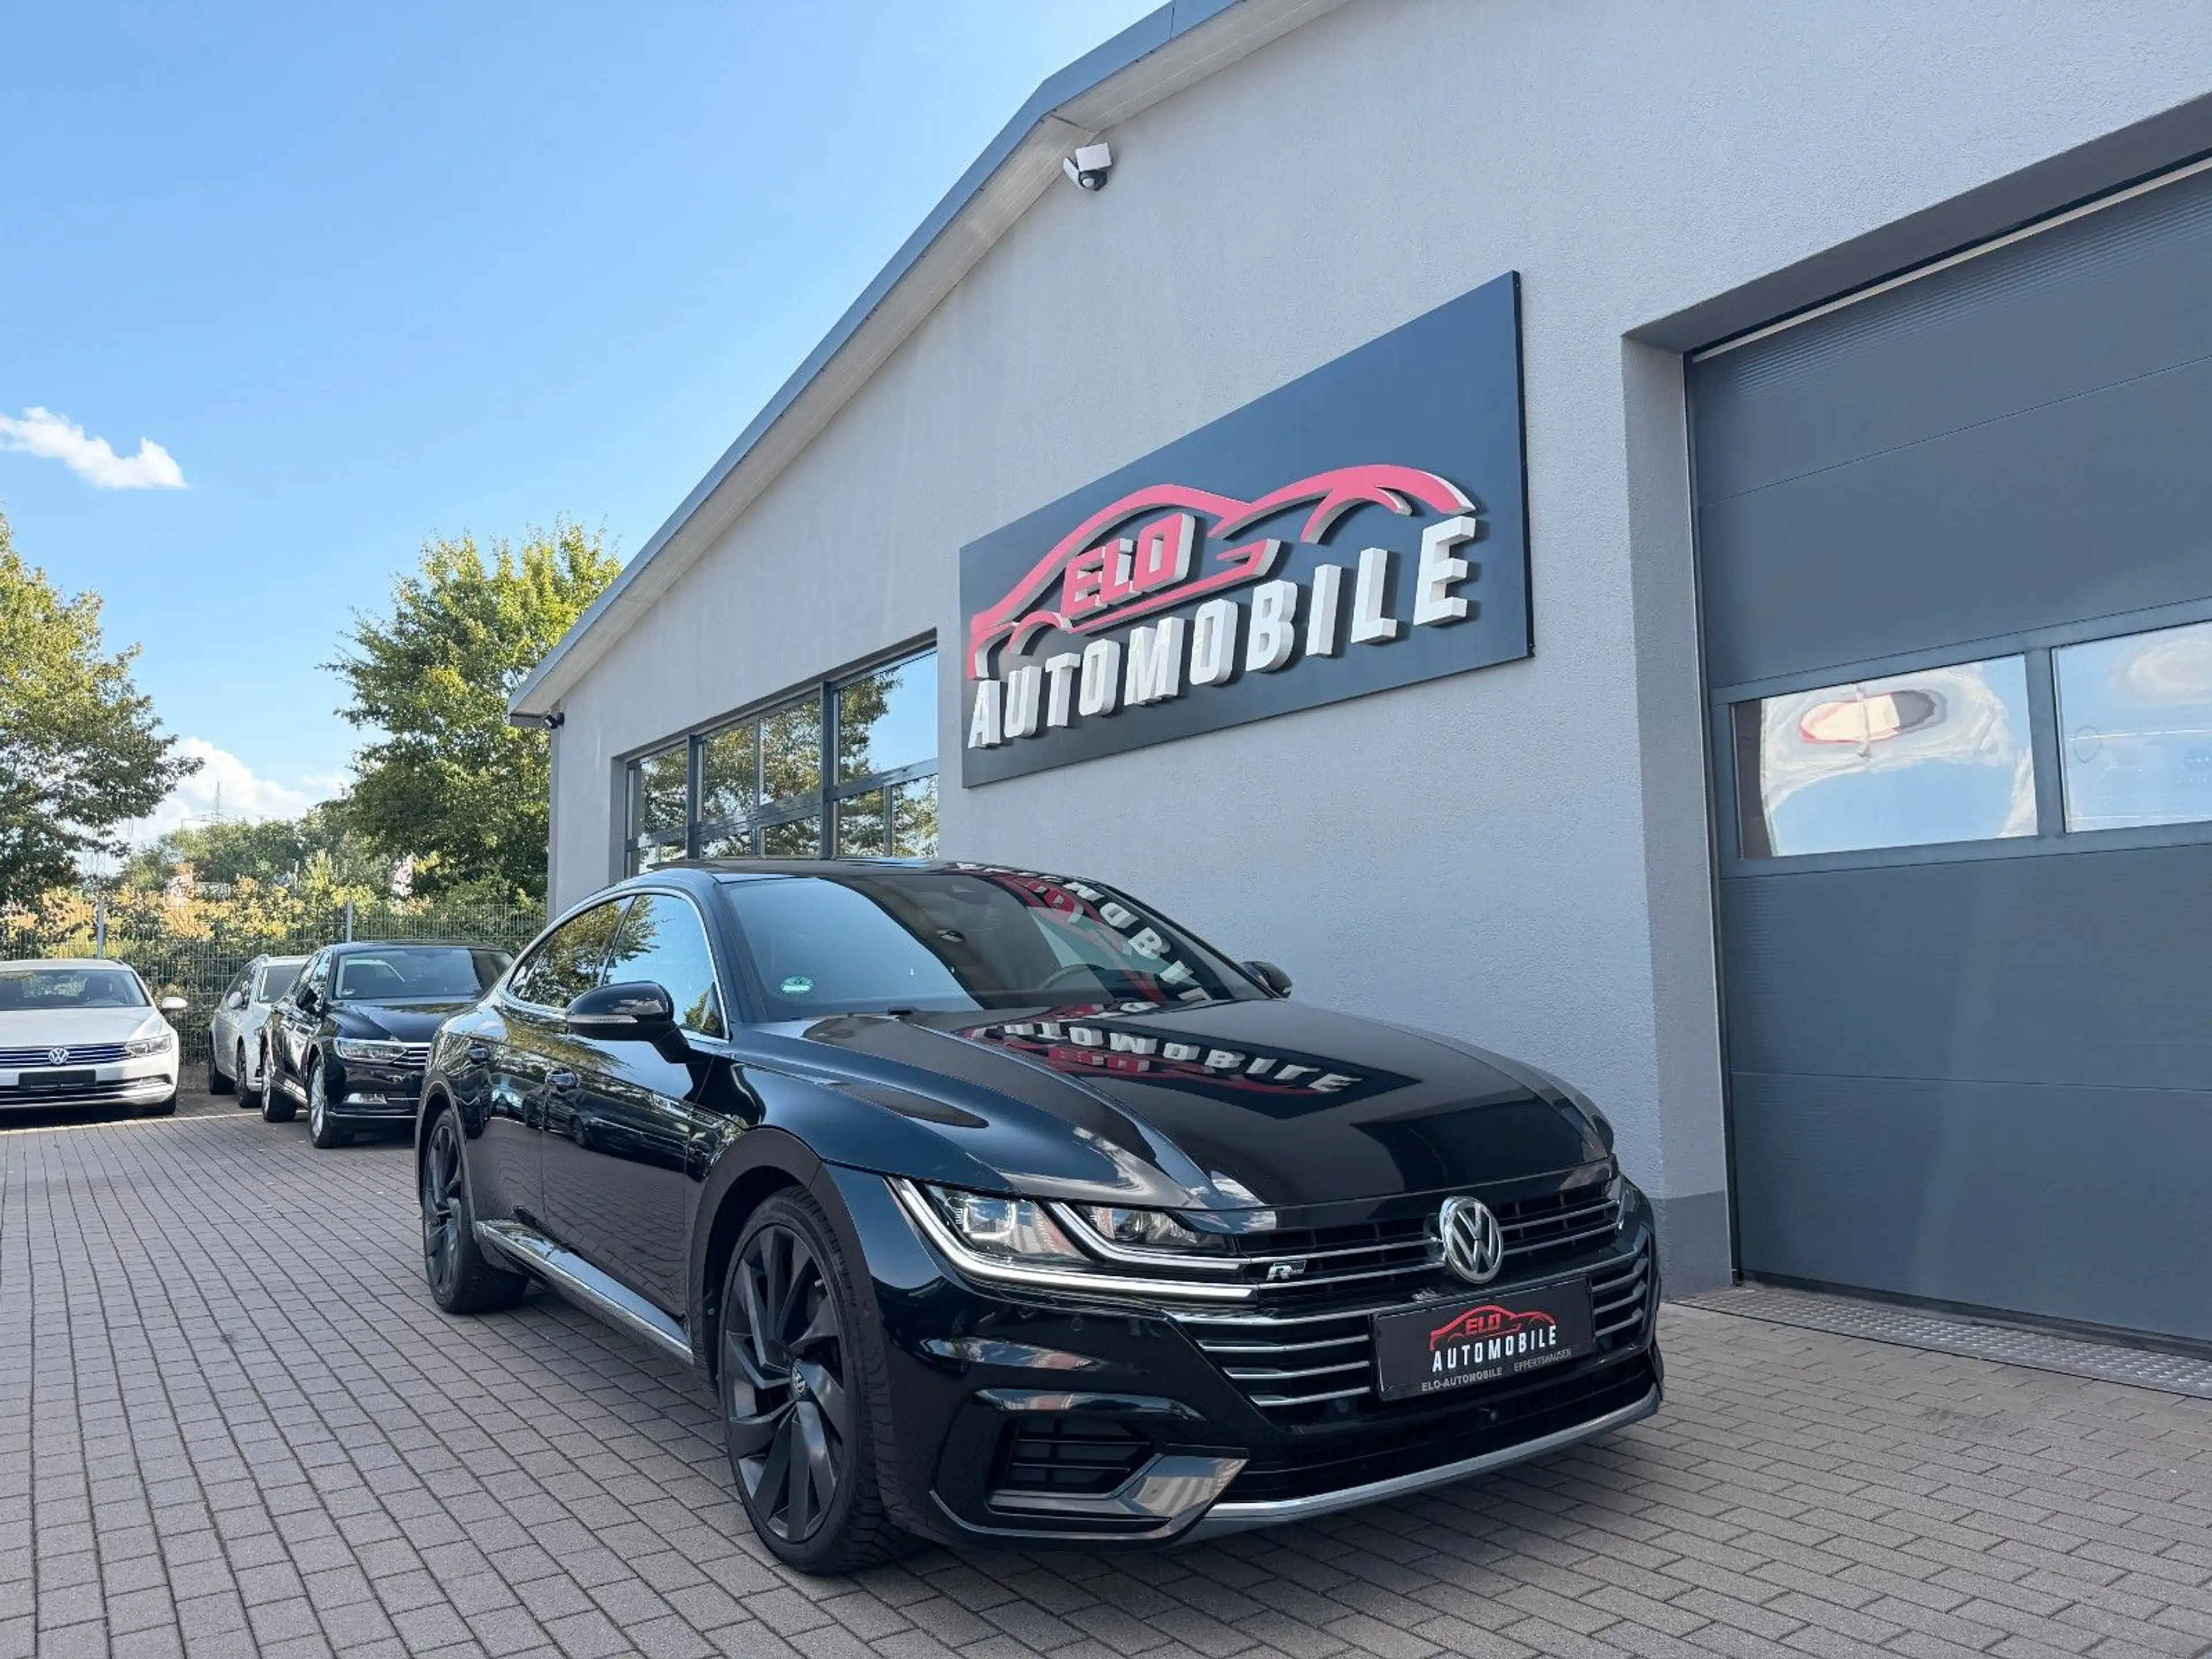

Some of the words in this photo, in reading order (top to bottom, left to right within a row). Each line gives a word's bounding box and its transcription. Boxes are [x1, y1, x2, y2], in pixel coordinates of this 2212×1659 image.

[1060, 512, 1196, 620] ELO
[968, 516, 1477, 749] AUTOMOBILE
[1442, 1196, 1503, 1284] VW
[1432, 1325, 1556, 1373] AUTOMOBILE
[1465, 1313, 1501, 1336] ELO
[1421, 1366, 1502, 1392] ELO-AUTOMOBILE
[1513, 1348, 1572, 1372] EPPERTSHAUSEN
